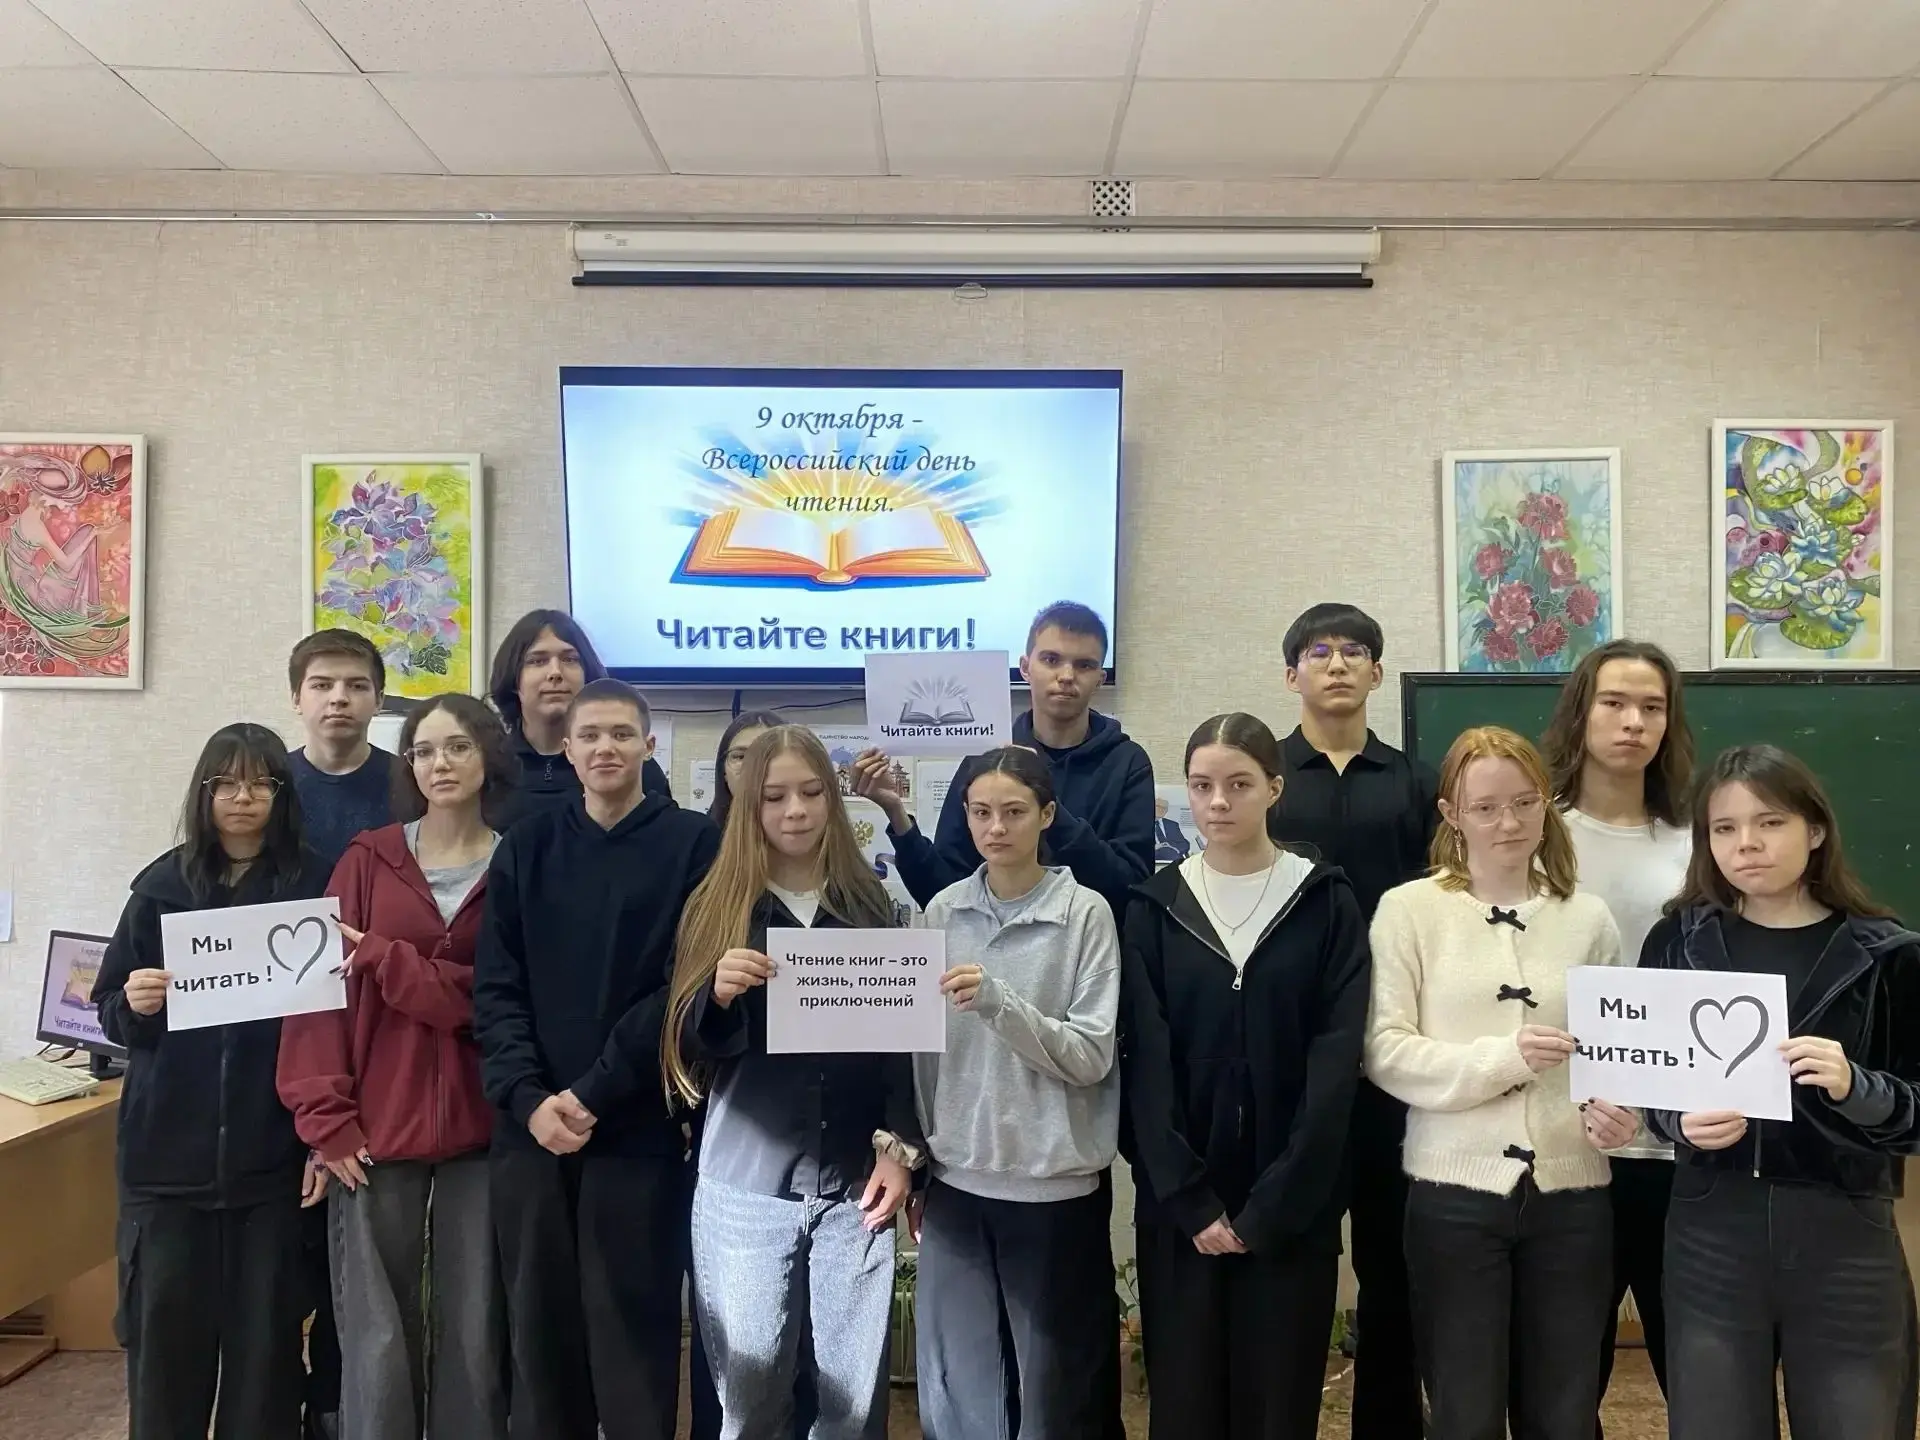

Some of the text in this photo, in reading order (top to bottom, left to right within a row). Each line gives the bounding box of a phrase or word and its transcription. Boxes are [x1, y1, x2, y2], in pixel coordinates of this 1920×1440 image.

[756, 406, 773, 430] 9
[781, 403, 904, 437] октября
[702, 446, 977, 477] Всероссийский день
[783, 494, 895, 514] чтения.
[657, 617, 976, 650] Читайте книги!
[880, 723, 995, 737] Читайте книги!
[191, 935, 232, 955] Мы
[786, 953, 845, 966] Чтение
[849, 956, 886, 966] книг
[900, 956, 928, 966] это
[174, 971, 260, 993] читать
[797, 976, 916, 988] жизнь, полная
[799, 995, 914, 1009] приключений
[1600, 997, 1647, 1020] Мы
[1578, 1045, 1679, 1067] читать
